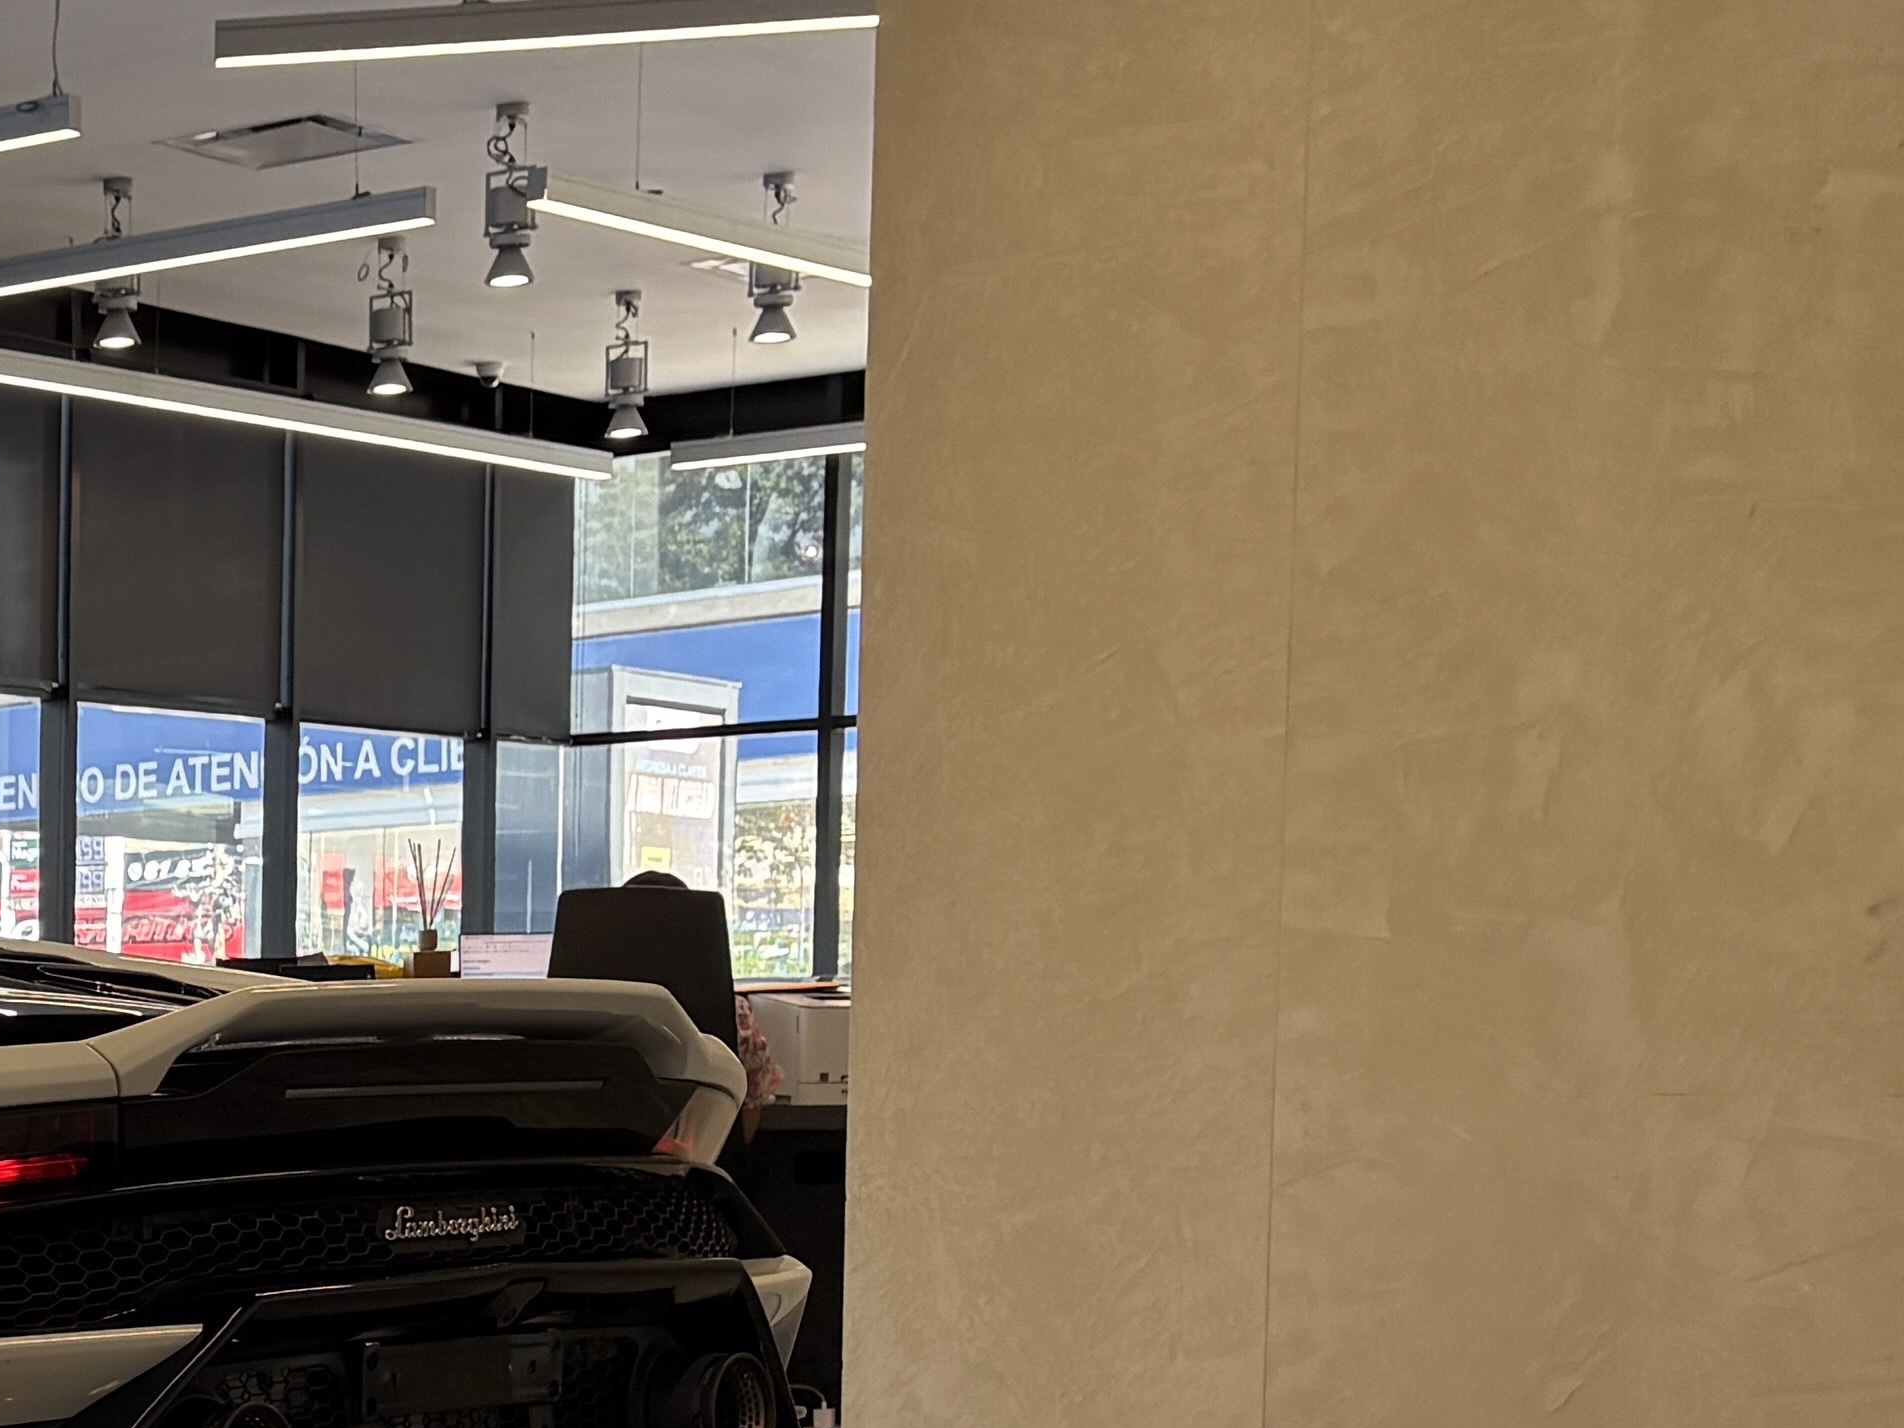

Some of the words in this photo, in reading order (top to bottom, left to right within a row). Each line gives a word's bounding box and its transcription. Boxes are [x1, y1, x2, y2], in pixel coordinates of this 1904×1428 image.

[115, 760, 158, 801] DE
[166, 735, 343, 796] ATENÓN
[354, 738, 382, 780] A
[391, 736, 464, 776] CLIE
[385, 1206, 520, 1243] Lamborghini
